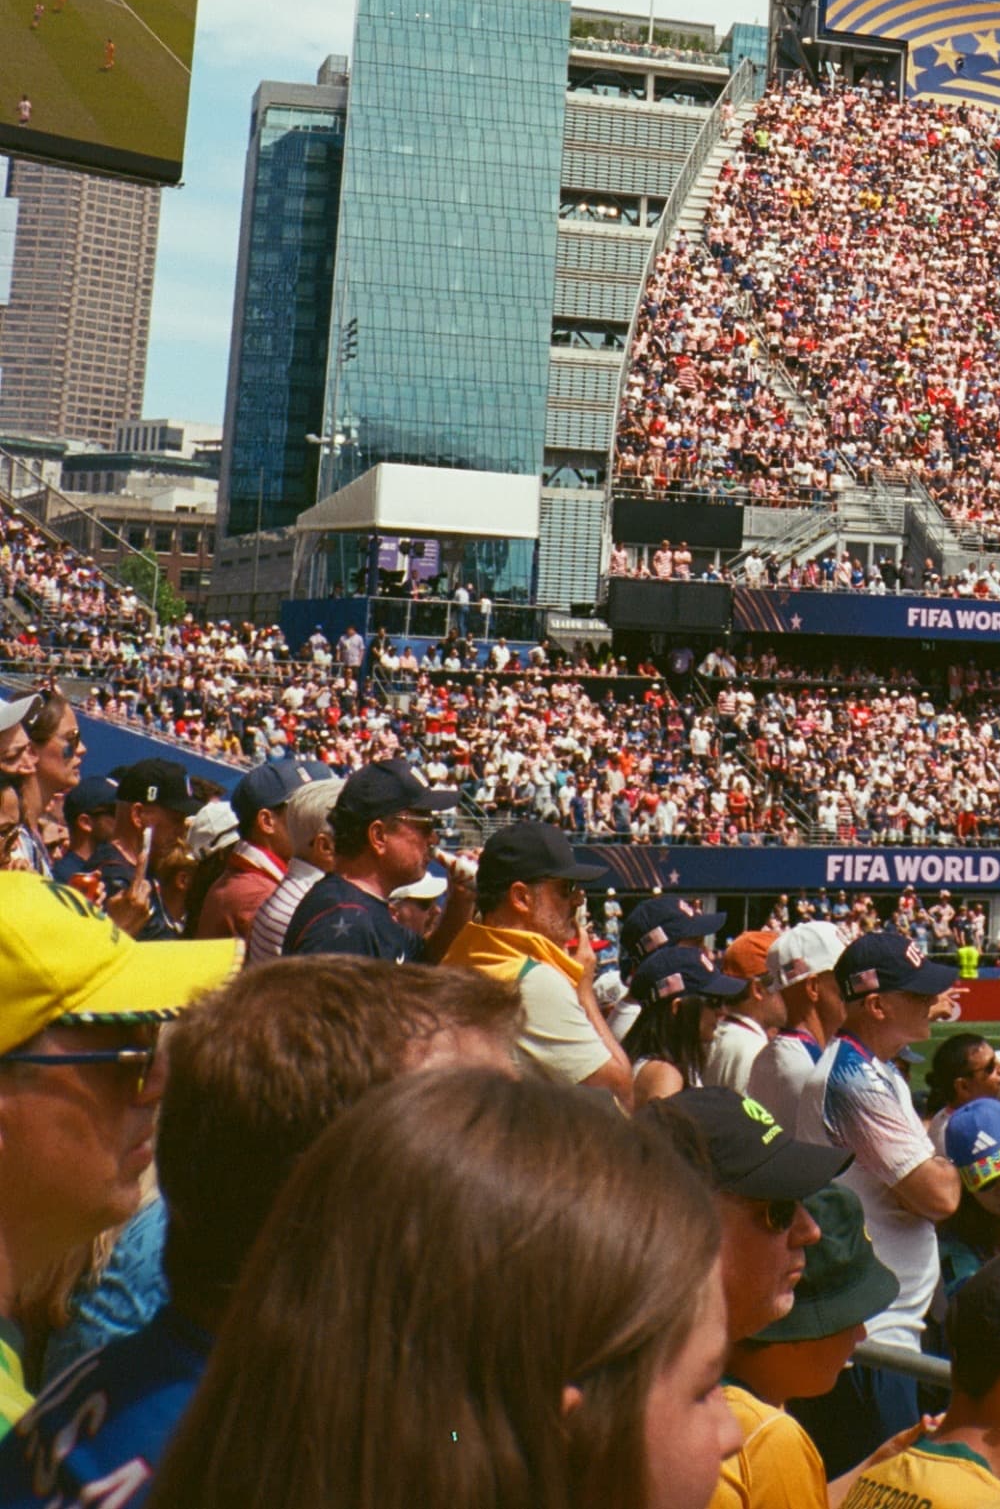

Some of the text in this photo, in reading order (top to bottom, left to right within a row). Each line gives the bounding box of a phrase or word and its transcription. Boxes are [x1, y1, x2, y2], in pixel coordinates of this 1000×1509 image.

[907, 607, 953, 629] FIFA
[826, 855, 890, 882] FIFA
[894, 855, 1000, 883] WORLD
